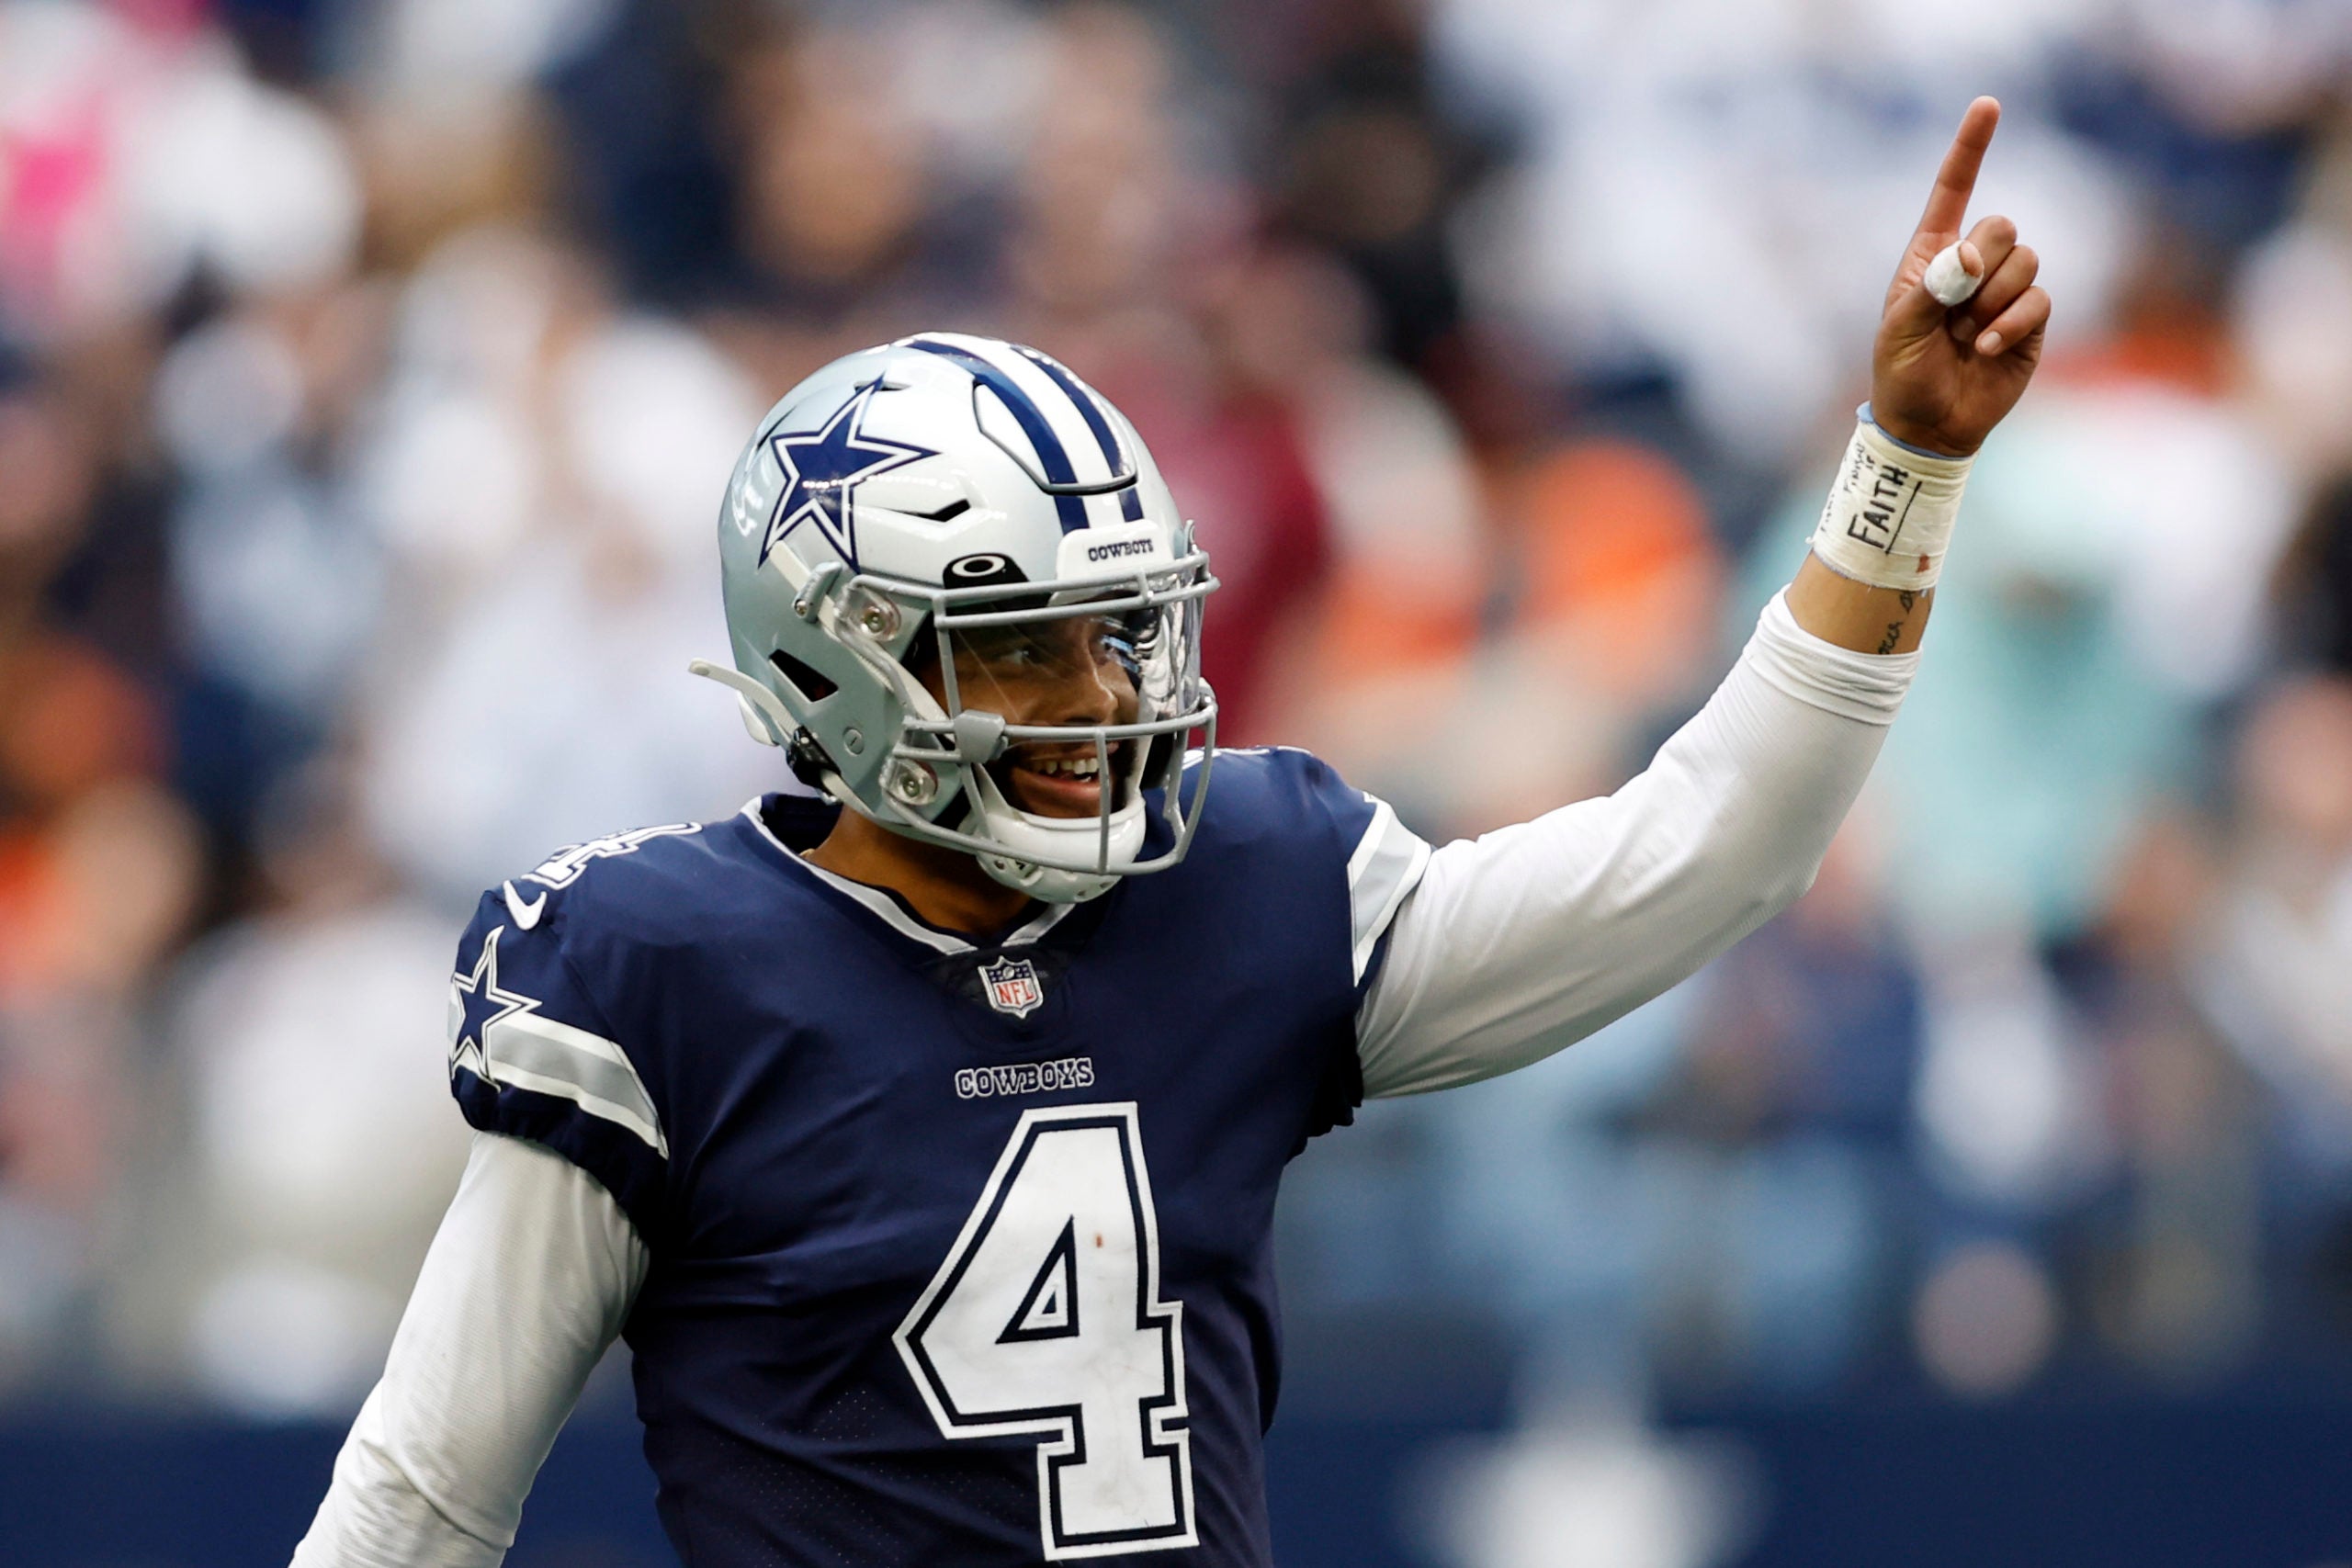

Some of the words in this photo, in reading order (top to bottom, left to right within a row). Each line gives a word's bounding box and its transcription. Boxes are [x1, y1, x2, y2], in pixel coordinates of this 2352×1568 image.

[1847, 465, 1908, 549] FAITH
[1088, 538, 1154, 562] COWBOYS
[996, 979, 1035, 1005] NFL
[955, 1057, 1095, 1099] COWBOYS
[891, 1100, 1200, 1562] 4
